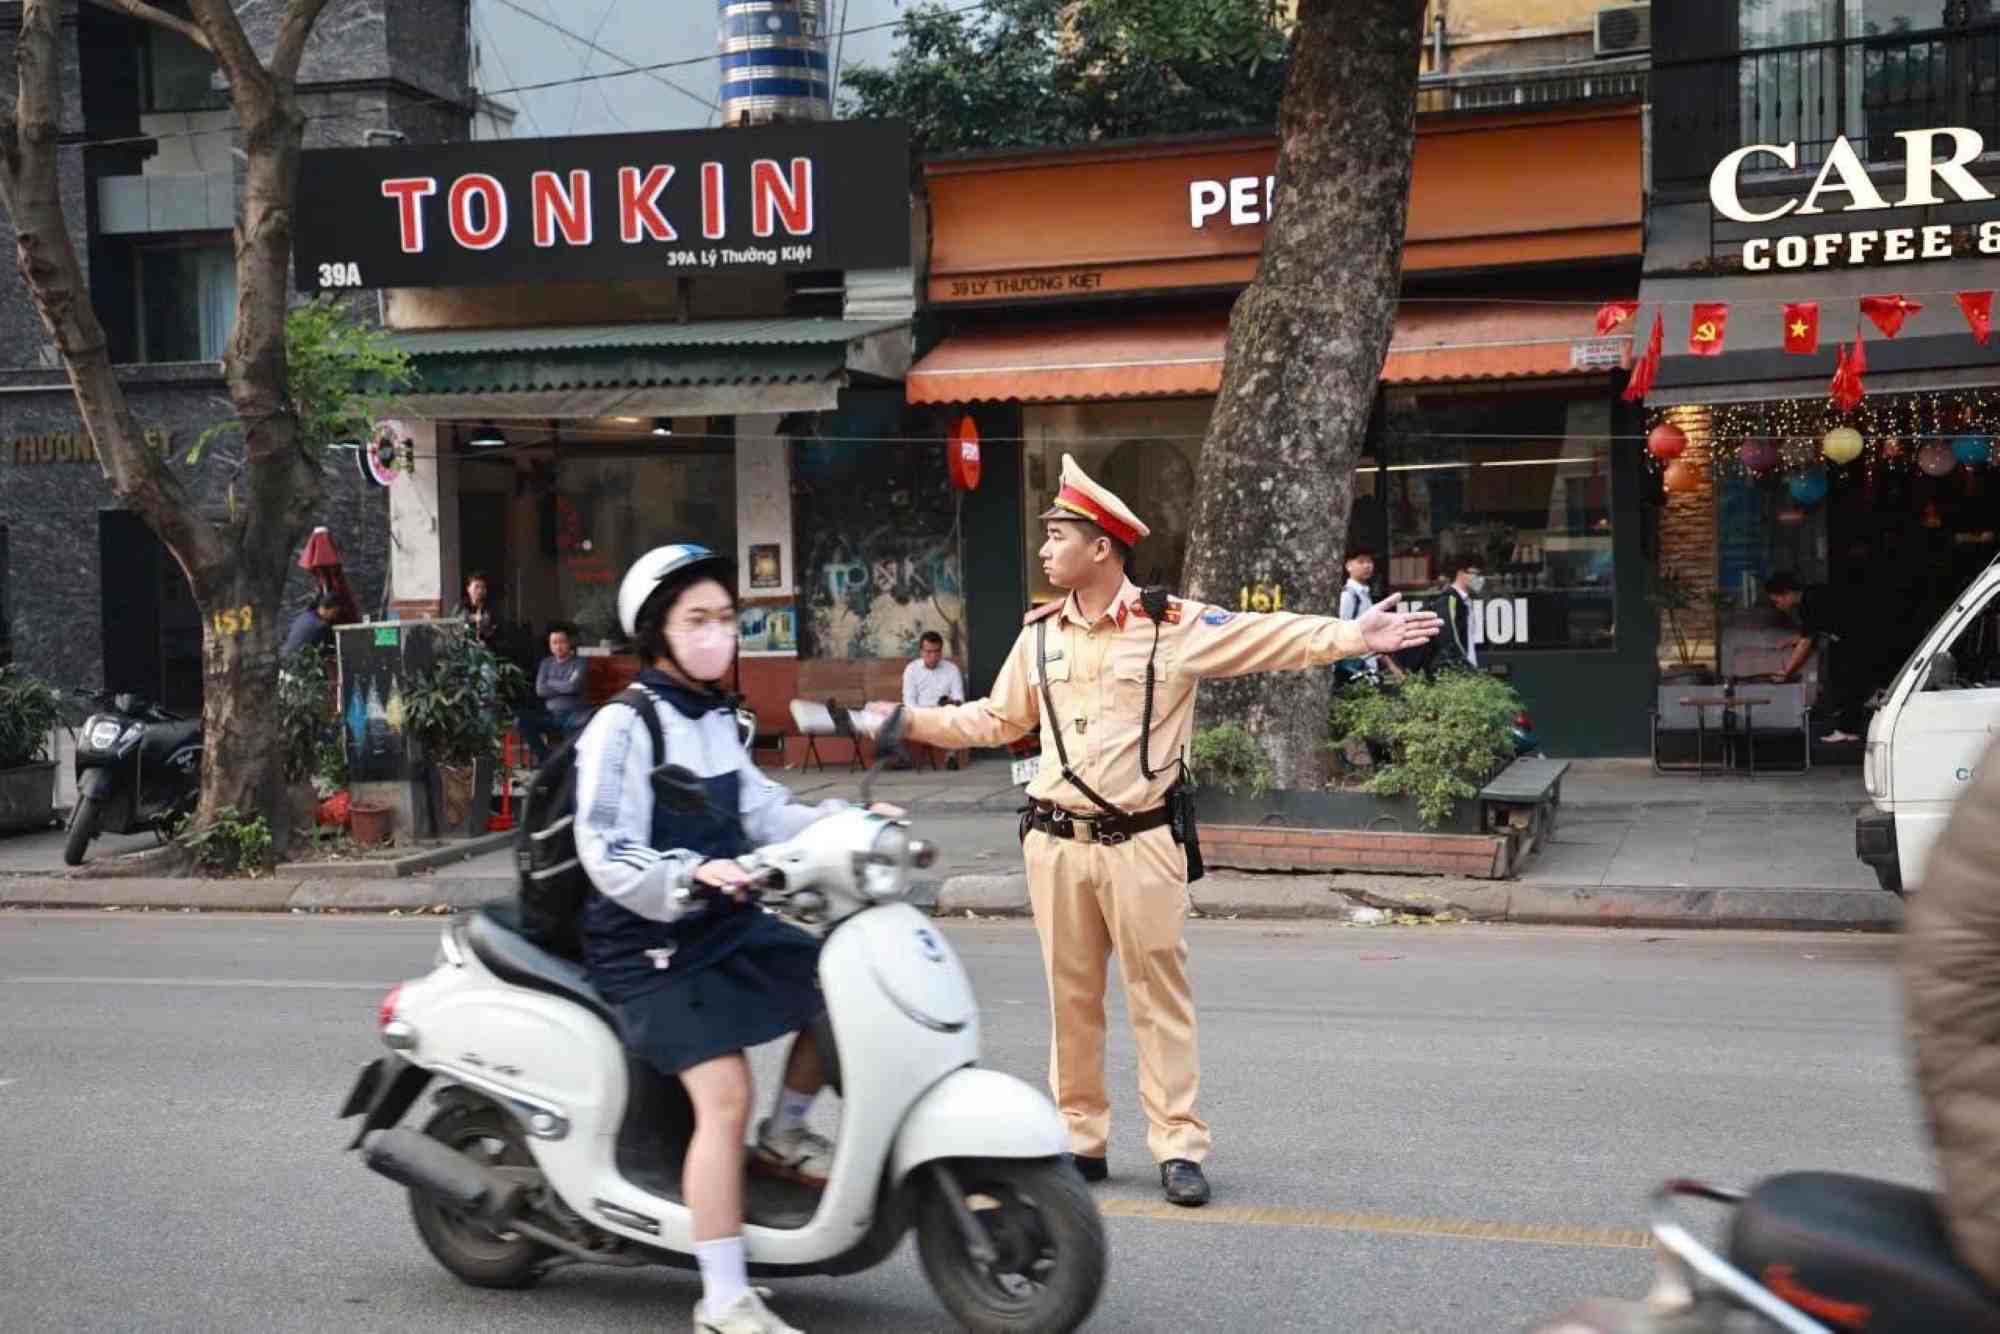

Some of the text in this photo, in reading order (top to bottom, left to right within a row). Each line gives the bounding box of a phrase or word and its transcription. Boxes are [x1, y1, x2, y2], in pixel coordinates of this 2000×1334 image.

[1709, 127, 1997, 223] CAR
[381, 157, 814, 253] TONKIN
[666, 244, 813, 268] 39A Lý Thường Kiệt
[1742, 224, 1952, 271] COFFEE
[318, 262, 362, 287] 39A
[1241, 583, 1282, 612] 161
